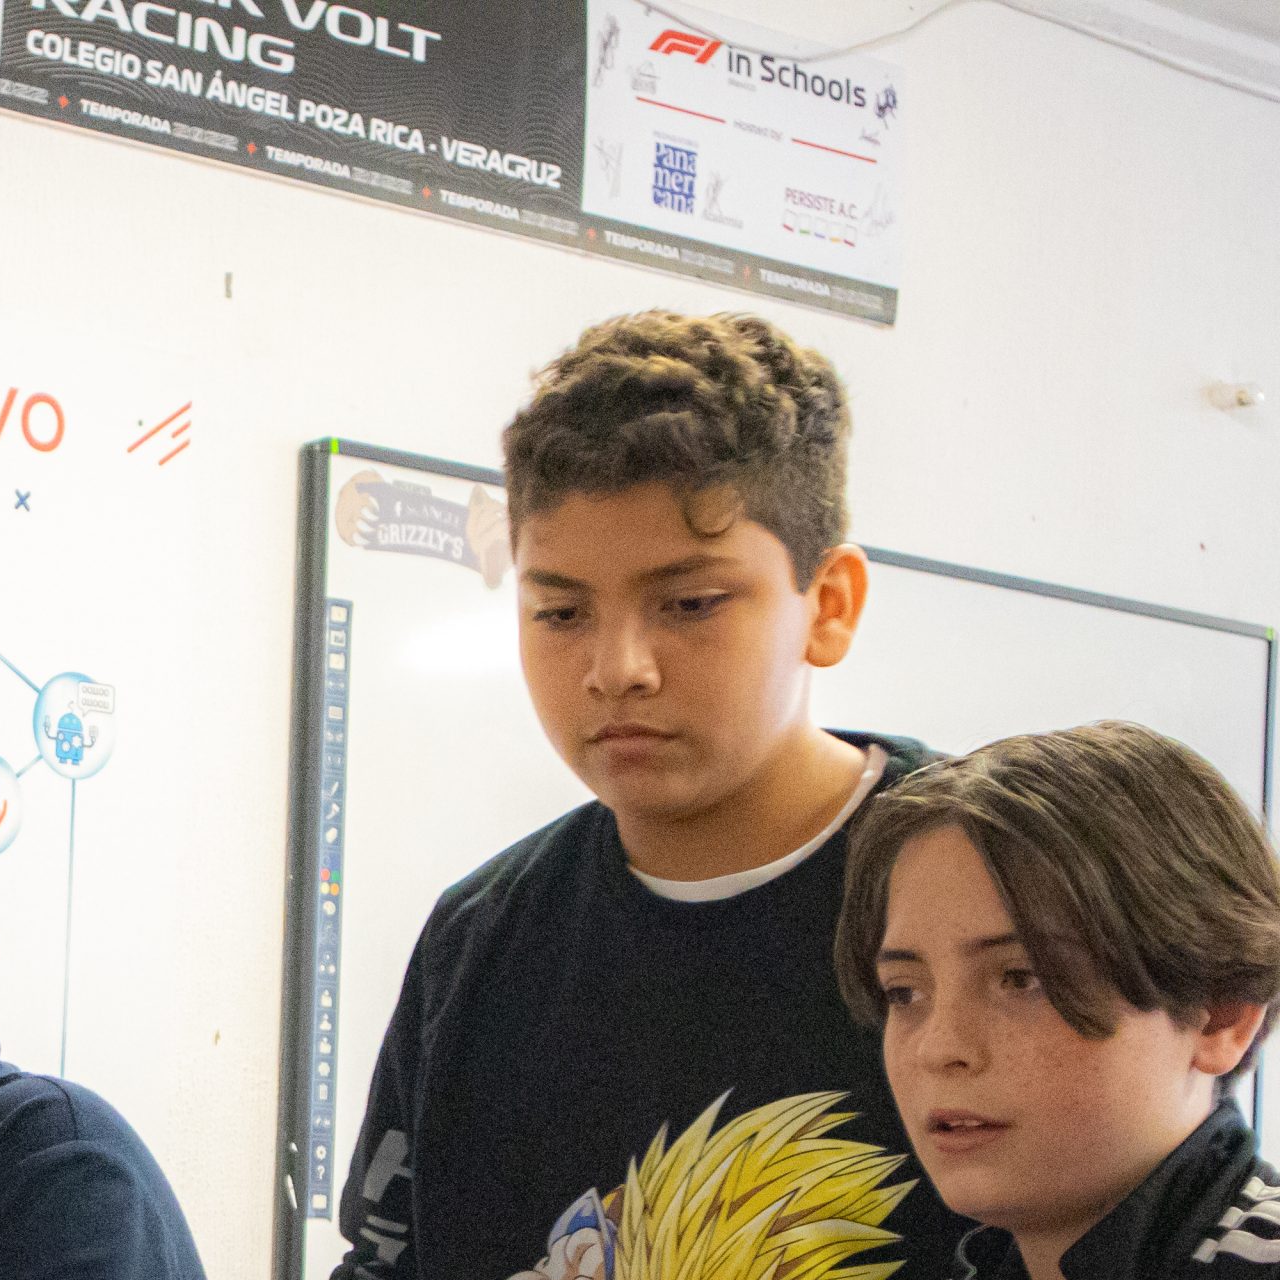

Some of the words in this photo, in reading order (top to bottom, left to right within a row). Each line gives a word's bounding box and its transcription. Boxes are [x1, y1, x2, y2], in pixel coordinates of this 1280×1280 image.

[32, 0, 296, 74] ACING
[282, 0, 442, 62] VOLT
[26, 29, 142, 81] COLEGIO
[145, 59, 204, 97] SAN
[205, 69, 295, 120] ÁNGEL
[298, 99, 366, 139] POZA
[369, 117, 426, 154] RICA
[440, 135, 562, 189] VERACRUZ
[727, 45, 752, 78] in
[760, 54, 867, 108] Schools
[80, 98, 172, 135] TEMPORADA
[265, 145, 352, 179] TEMPORADA
[439, 188, 520, 222] TEMPORADA
